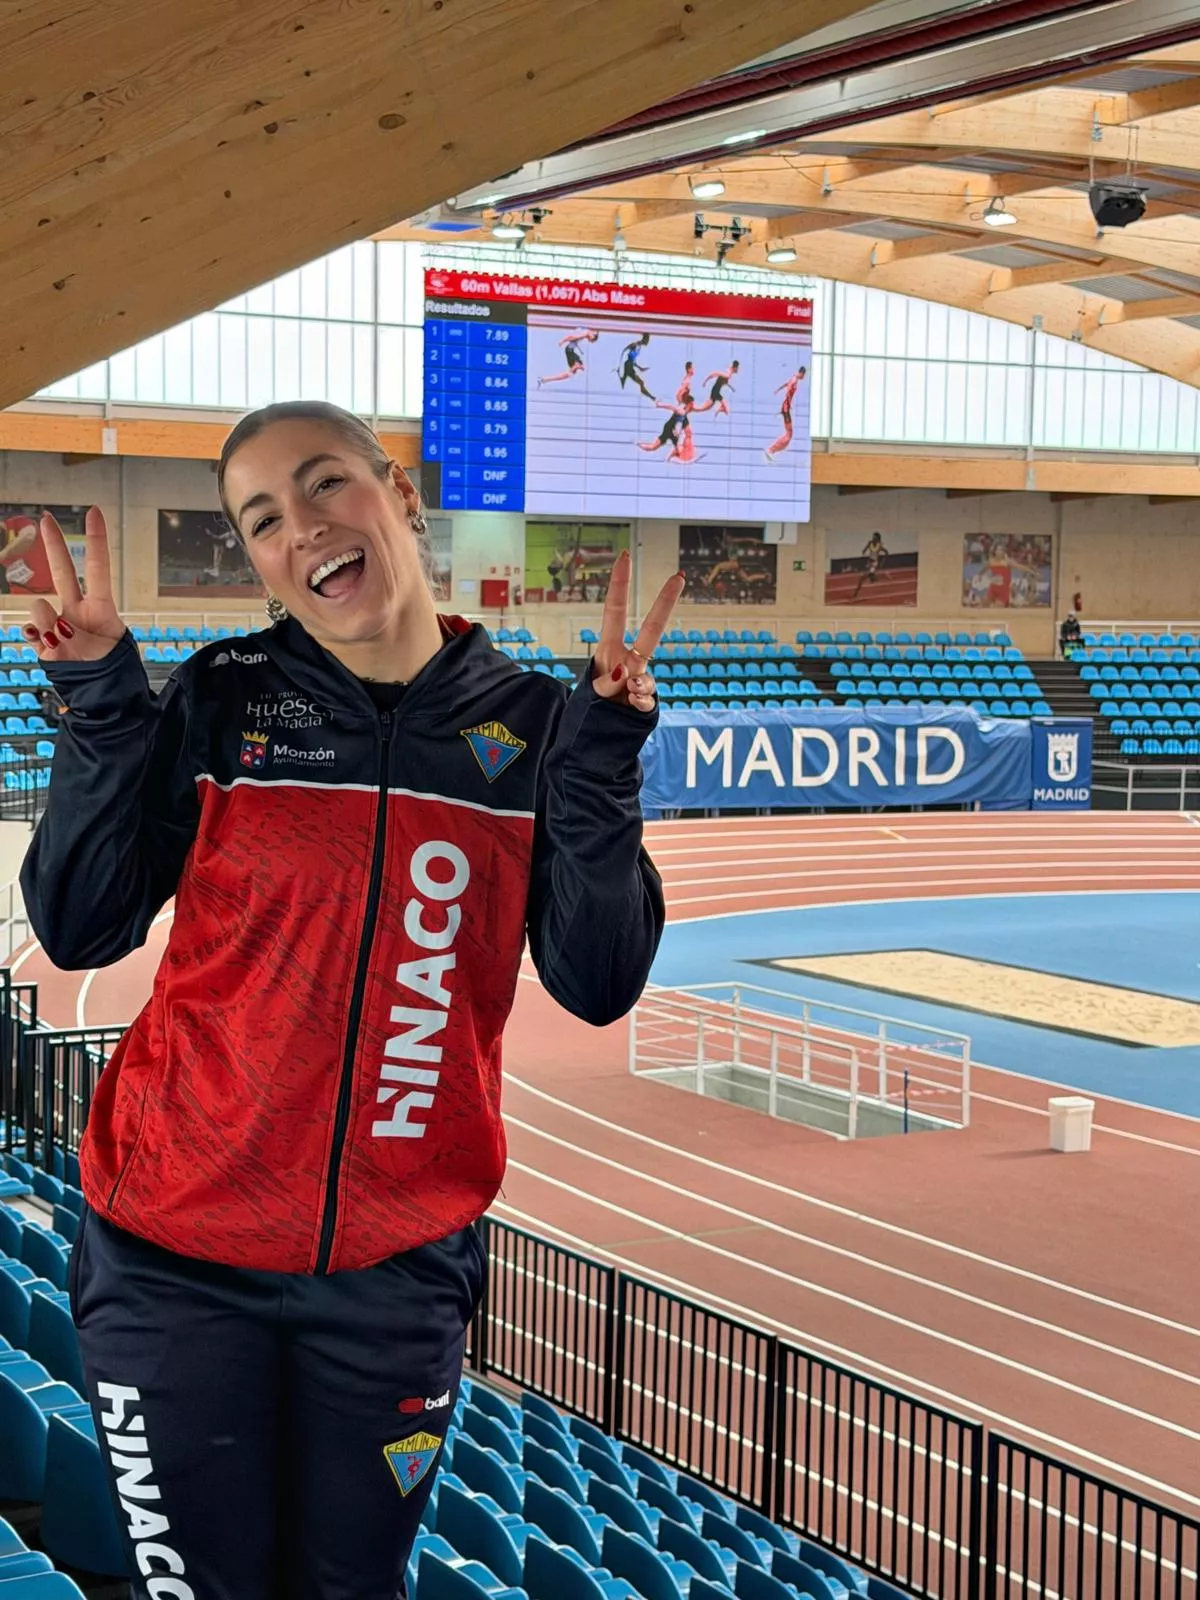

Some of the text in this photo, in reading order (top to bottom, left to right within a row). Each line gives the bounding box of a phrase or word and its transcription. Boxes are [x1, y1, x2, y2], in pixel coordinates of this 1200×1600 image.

[460, 278, 491, 294] 60m
[492, 280, 533, 298] Vallas
[581, 288, 608, 304] Abs
[610, 290, 646, 306] Masc
[425, 299, 491, 317] Resultados
[431, 325, 438, 336] 1
[430, 349, 439, 361] 2
[429, 373, 438, 385] 3
[429, 397, 438, 408] 4
[429, 420, 438, 432] 5
[428, 444, 438, 456] 6
[482, 469, 508, 482] DNF
[482, 493, 508, 505] DNF
[273, 744, 335, 760] Monzón
[686, 727, 966, 788] MADRID
[1033, 787, 1090, 801] MADRID
[371, 840, 471, 1138] HINACO
